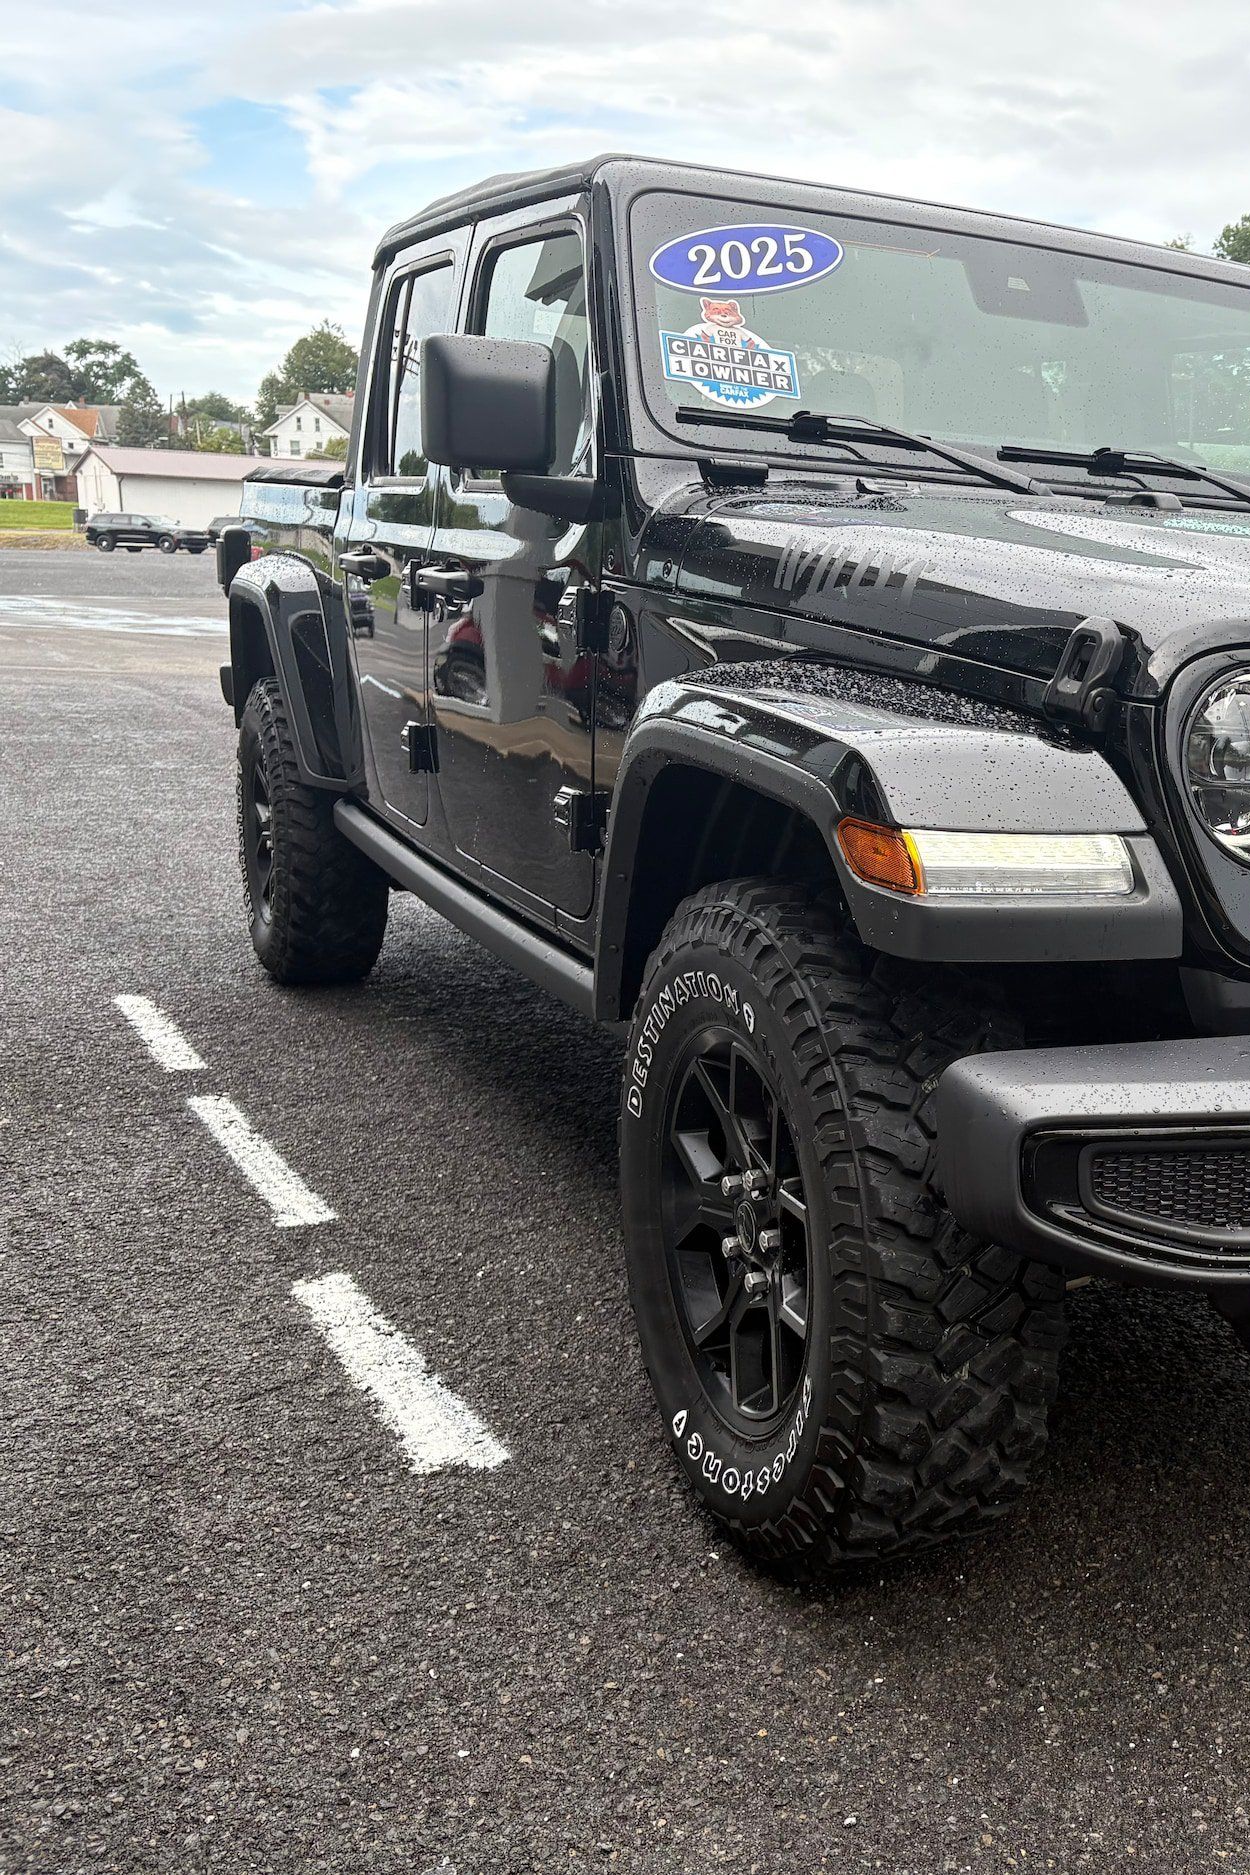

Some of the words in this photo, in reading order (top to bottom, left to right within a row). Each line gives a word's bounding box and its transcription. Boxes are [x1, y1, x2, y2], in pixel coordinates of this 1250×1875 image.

[688, 233, 813, 285] 2025
[717, 329, 737, 339] CAR
[719, 337, 737, 346] FOX
[671, 340, 787, 373] CARFAX
[671, 360, 687, 374] 1
[694, 362, 792, 391] OWNER
[627, 971, 741, 1119] DESTINATION
